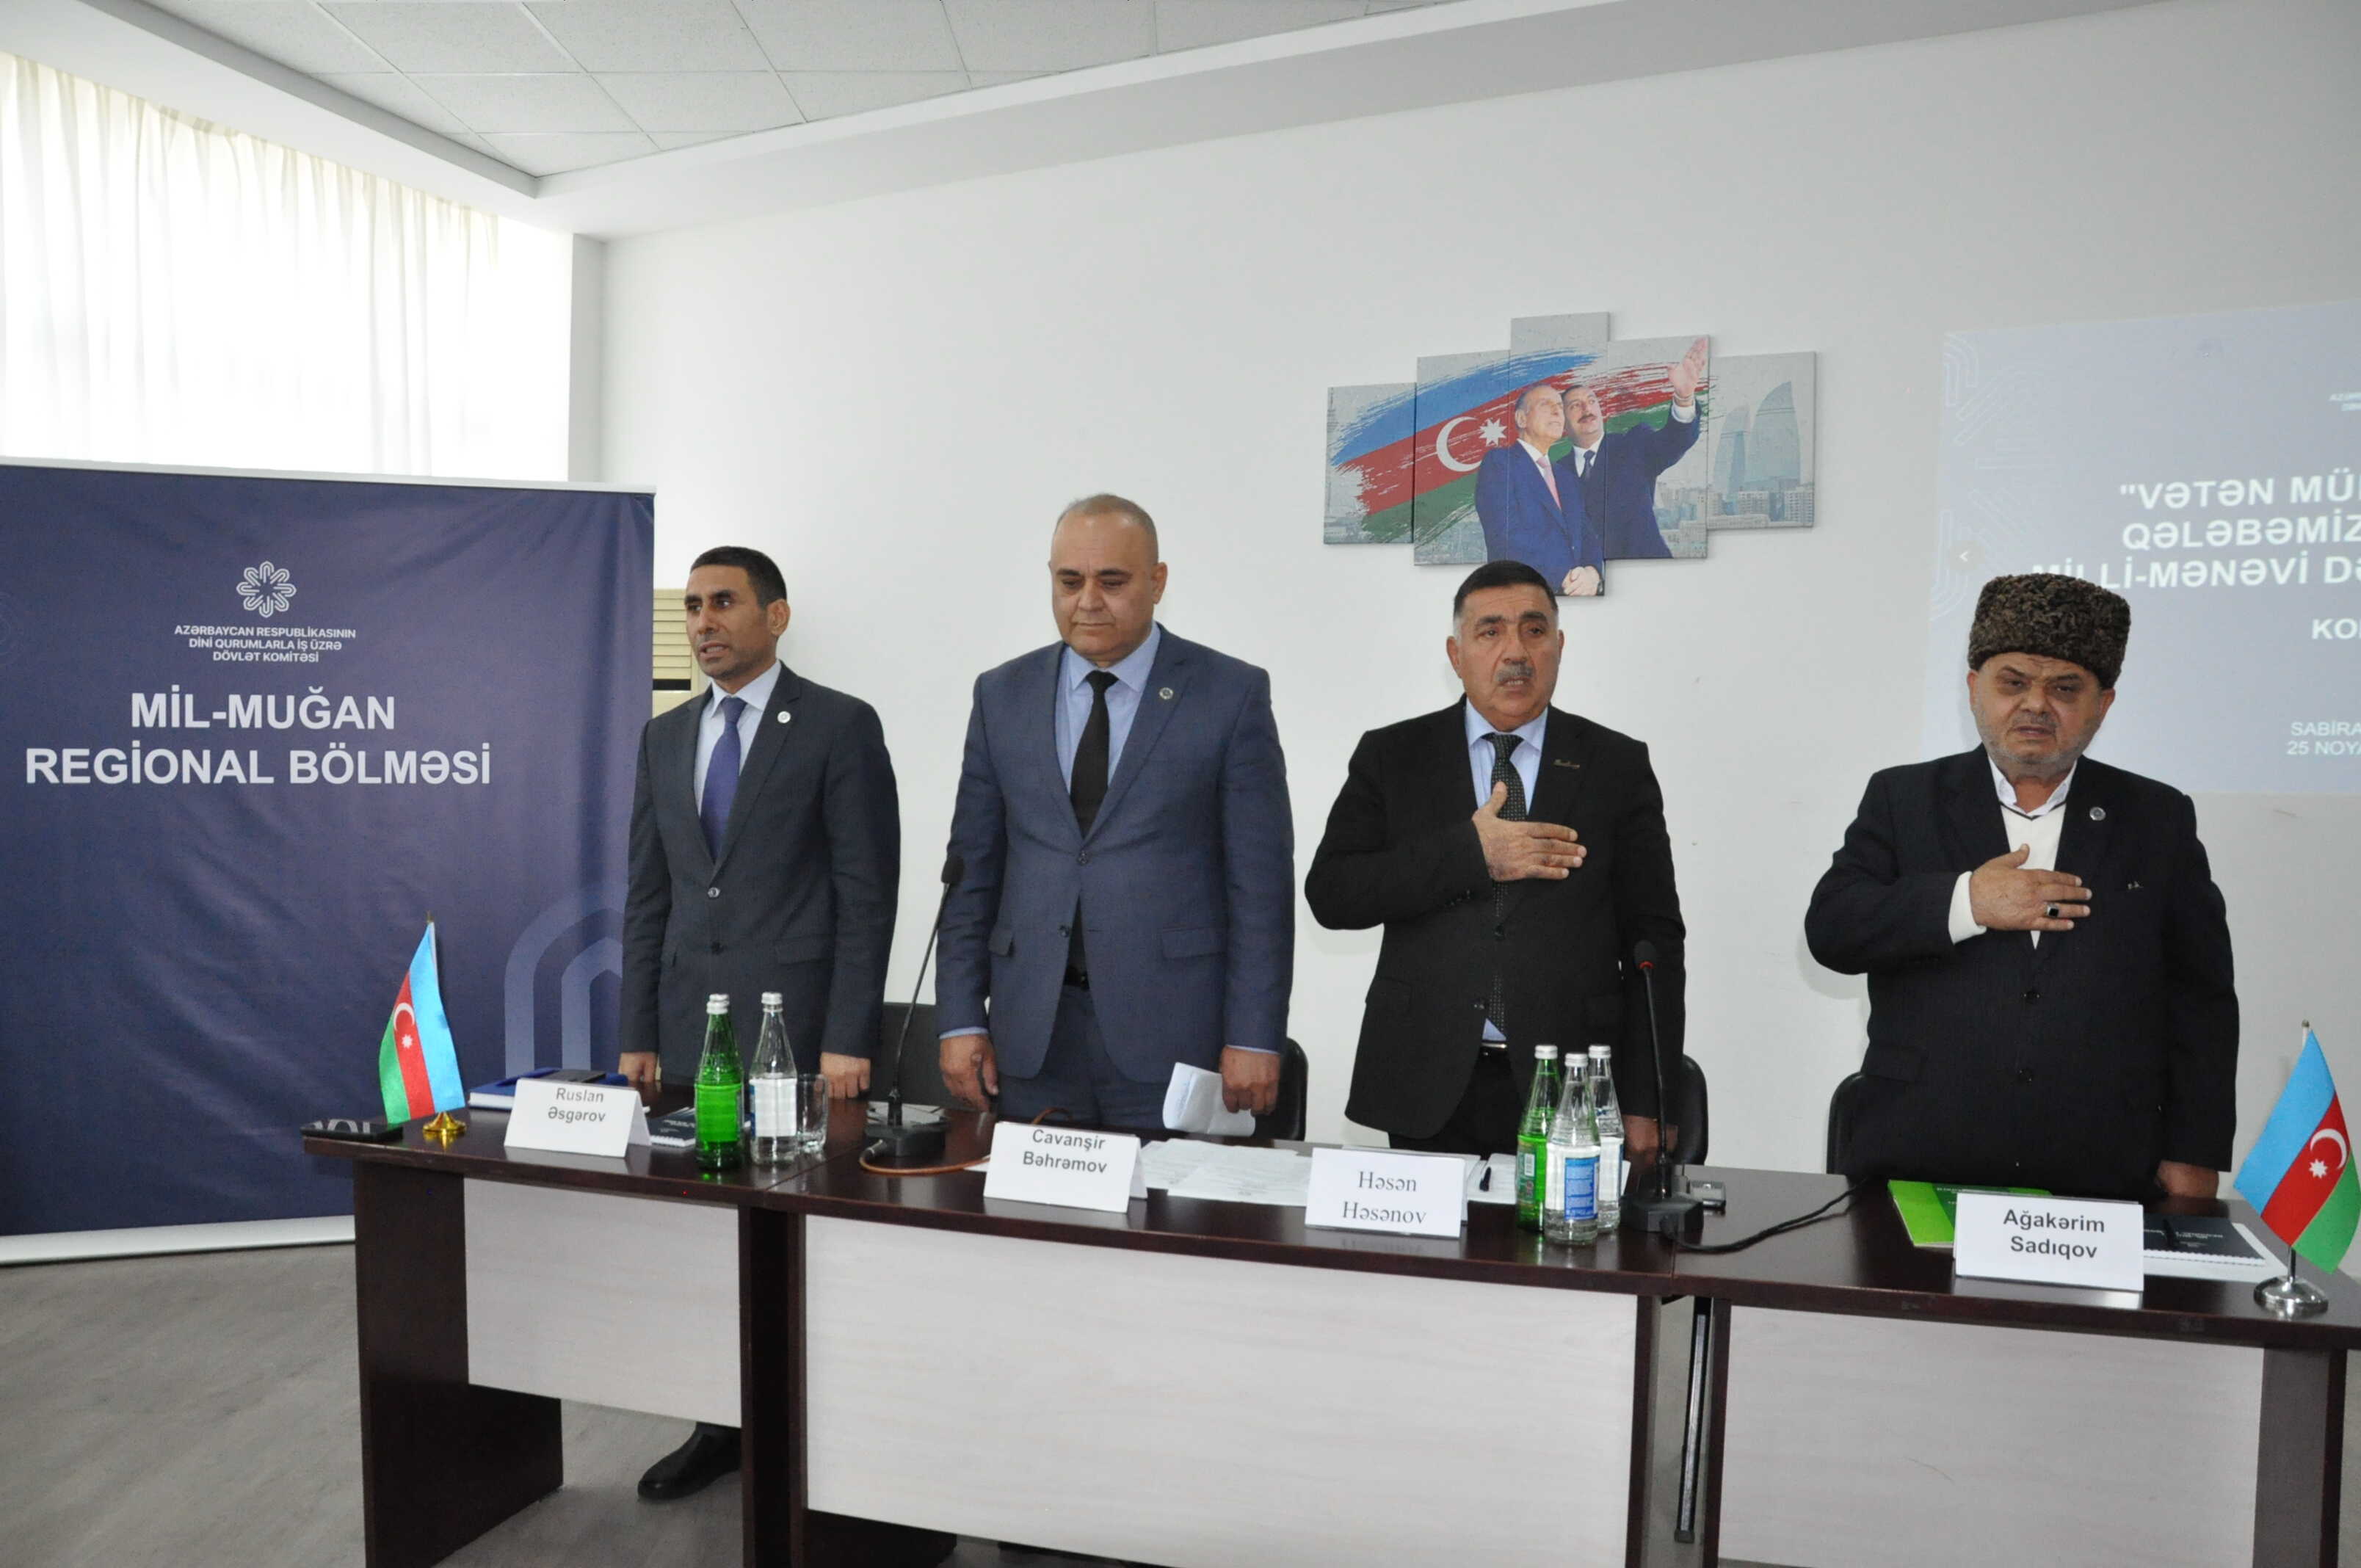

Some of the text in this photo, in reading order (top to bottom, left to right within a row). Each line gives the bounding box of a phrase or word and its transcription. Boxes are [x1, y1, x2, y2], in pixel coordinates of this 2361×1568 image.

[2120, 467, 2361, 509] "VƏTƏN MÜ
[2324, 556, 2361, 584] D
[174, 625, 356, 639] AZƏRBAYCAN RESPUBLİKASININ
[2312, 618, 2361, 639] KO
[189, 636, 342, 651] DİNİ QURUMLARLA İŞ ÜZRƏ
[213, 650, 319, 663] DÖVLƏT KOMİTƏSİ
[131, 684, 396, 730] MİL-MUĞAN
[2286, 740, 2310, 755] 25
[26, 740, 490, 785] REGİONAL BÖLMƏSİ
[556, 1087, 604, 1103] Ruslan
[548, 1106, 606, 1124] Əsgərov
[1032, 1129, 1106, 1152] Cavanşir
[1023, 1150, 1107, 1173] Bəhrəmov
[1358, 1171, 1417, 1192] Həsən
[1342, 1201, 1426, 1224] Həsənov
[2003, 1209, 2105, 1233] Ağakərim
[2010, 1235, 2097, 1260] Sadıqov
